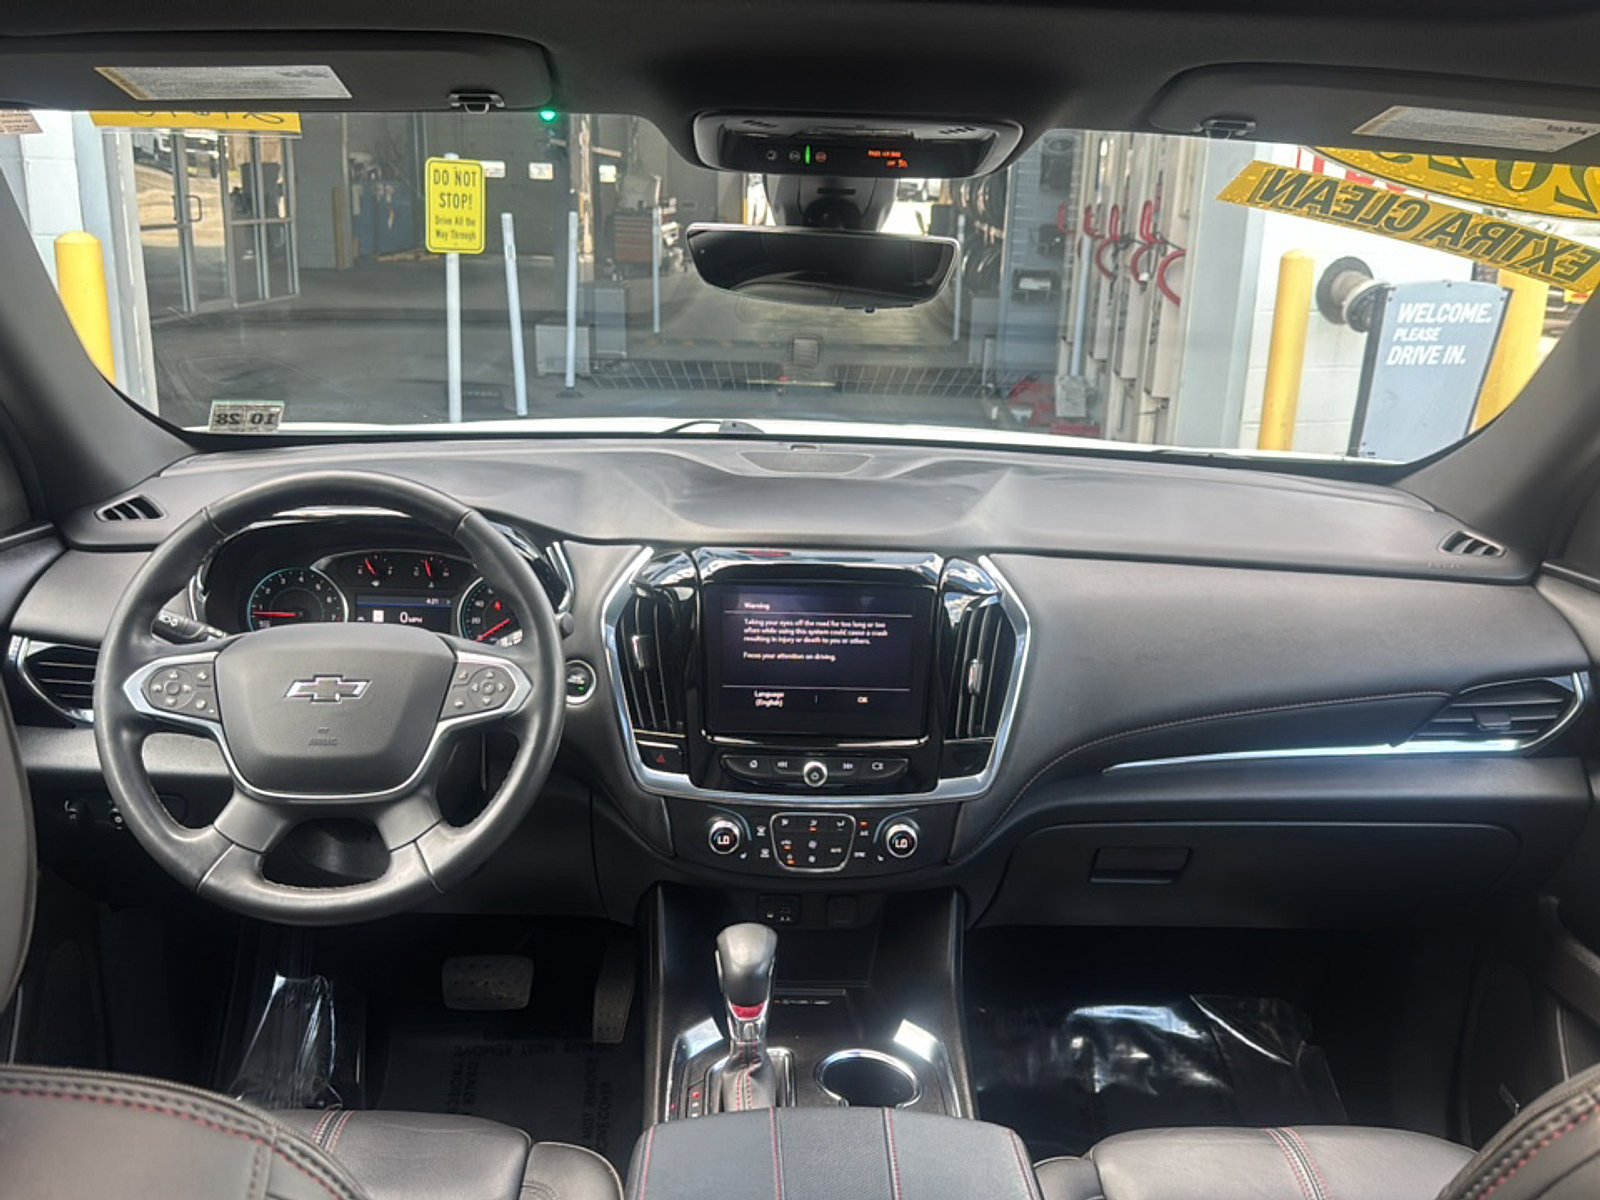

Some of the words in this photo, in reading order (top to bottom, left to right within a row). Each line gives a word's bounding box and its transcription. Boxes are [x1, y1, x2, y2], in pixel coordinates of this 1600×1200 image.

[433, 170, 449, 185] DO
[454, 171, 477, 187] NOT
[439, 192, 473, 210] STOP!
[455, 217, 464, 226] All
[436, 230, 448, 241] Way
[450, 230, 476, 241] Through
[1397, 302, 1493, 324] WELCOME.
[1392, 327, 1442, 342] PLEASE
[1386, 346, 1443, 365] DRIVE
[1442, 345, 1467, 365] IN.
[474, 599, 485, 608] 40
[743, 602, 770, 612] Warning
[400, 611, 408, 624] 0
[471, 616, 482, 625] 20
[744, 618, 765, 628] Taking
[743, 651, 761, 660] Focus
[754, 690, 785, 699] Language
[755, 699, 784, 708] (English)
